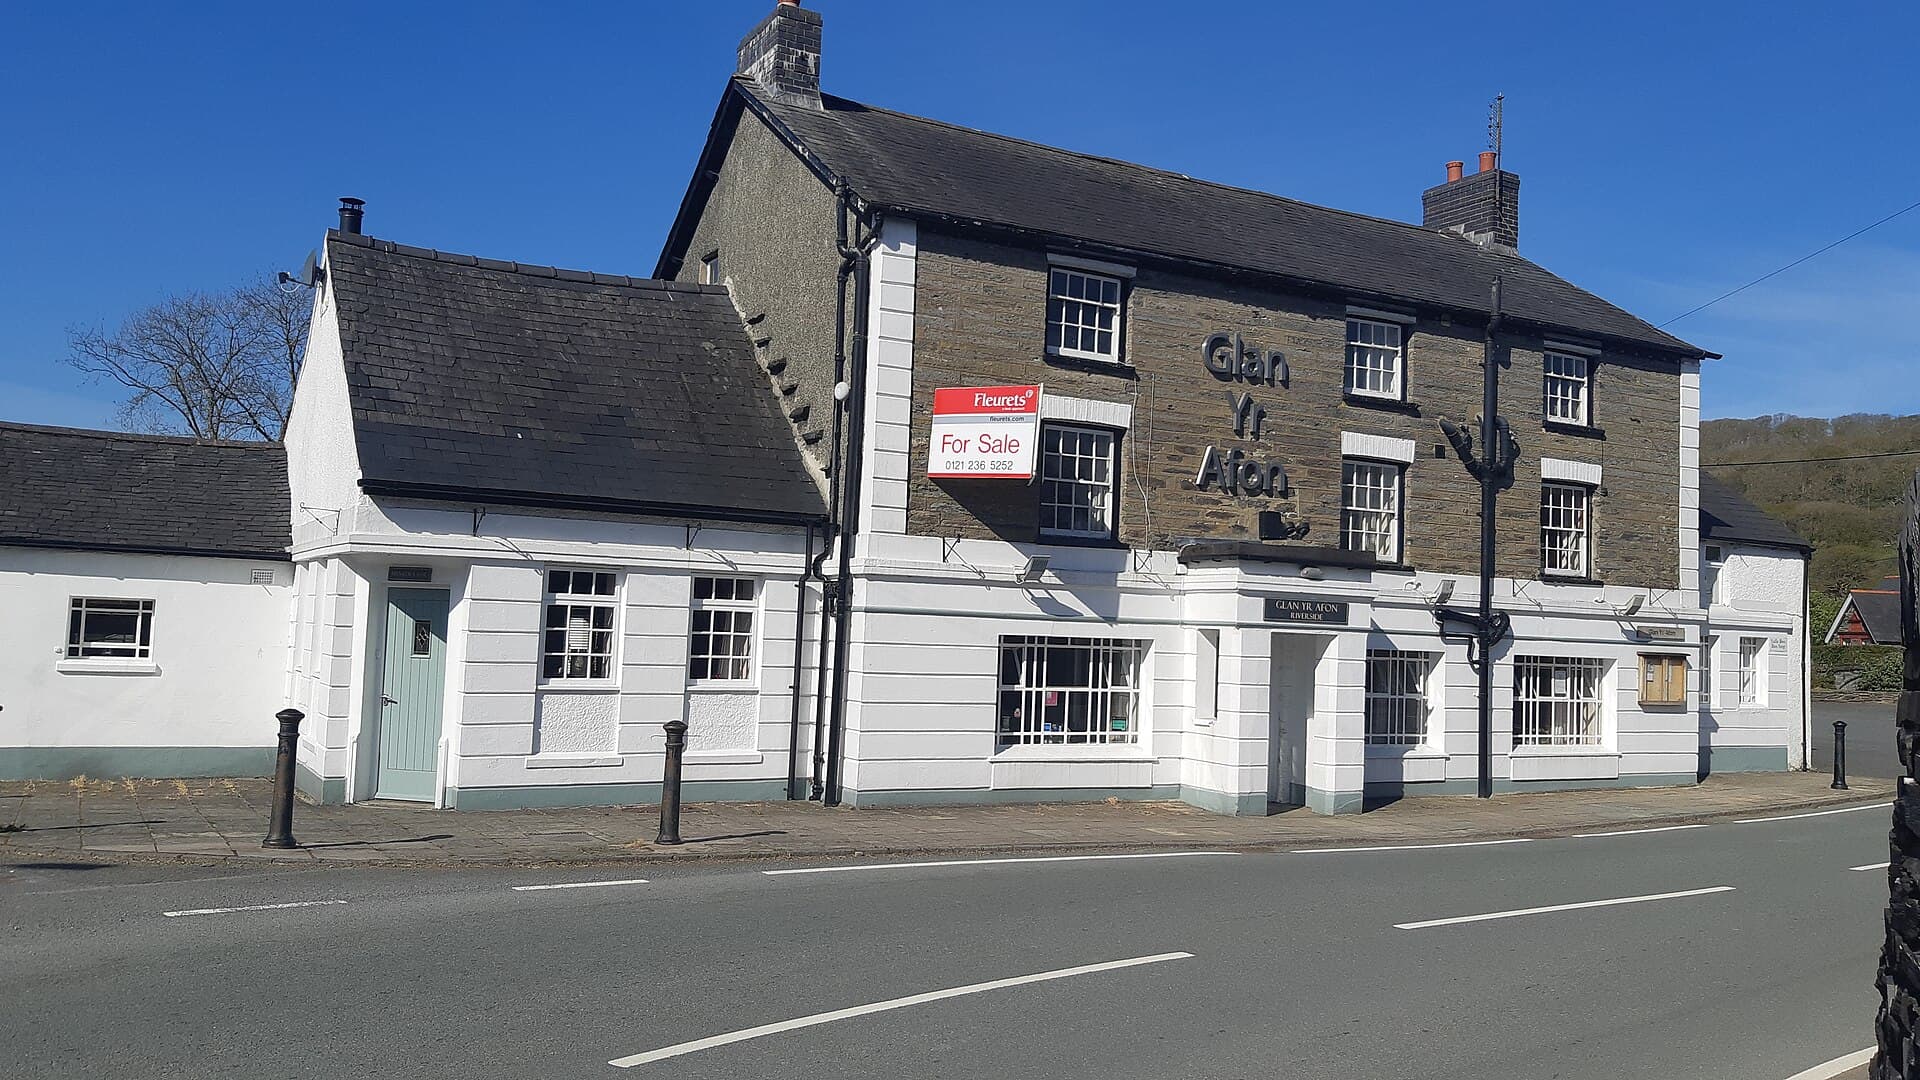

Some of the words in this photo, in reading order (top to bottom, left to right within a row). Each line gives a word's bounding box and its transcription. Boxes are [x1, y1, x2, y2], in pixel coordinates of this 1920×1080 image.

[1202, 331, 1287, 382] Glan
[974, 392, 1026, 407] Fleurets
[1225, 391, 1266, 435] Yr
[941, 434, 970, 454] For
[978, 433, 1020, 454] Sale
[945, 460, 964, 470] 0121
[967, 460, 986, 470] 236
[990, 460, 1014, 470] 5252
[1196, 445, 1287, 493] Afon
[1275, 600, 1299, 610] GLAN
[1301, 602, 1313, 611] YR
[1315, 603, 1338, 613] AFON
[1290, 612, 1323, 620] RIVERSIDE
